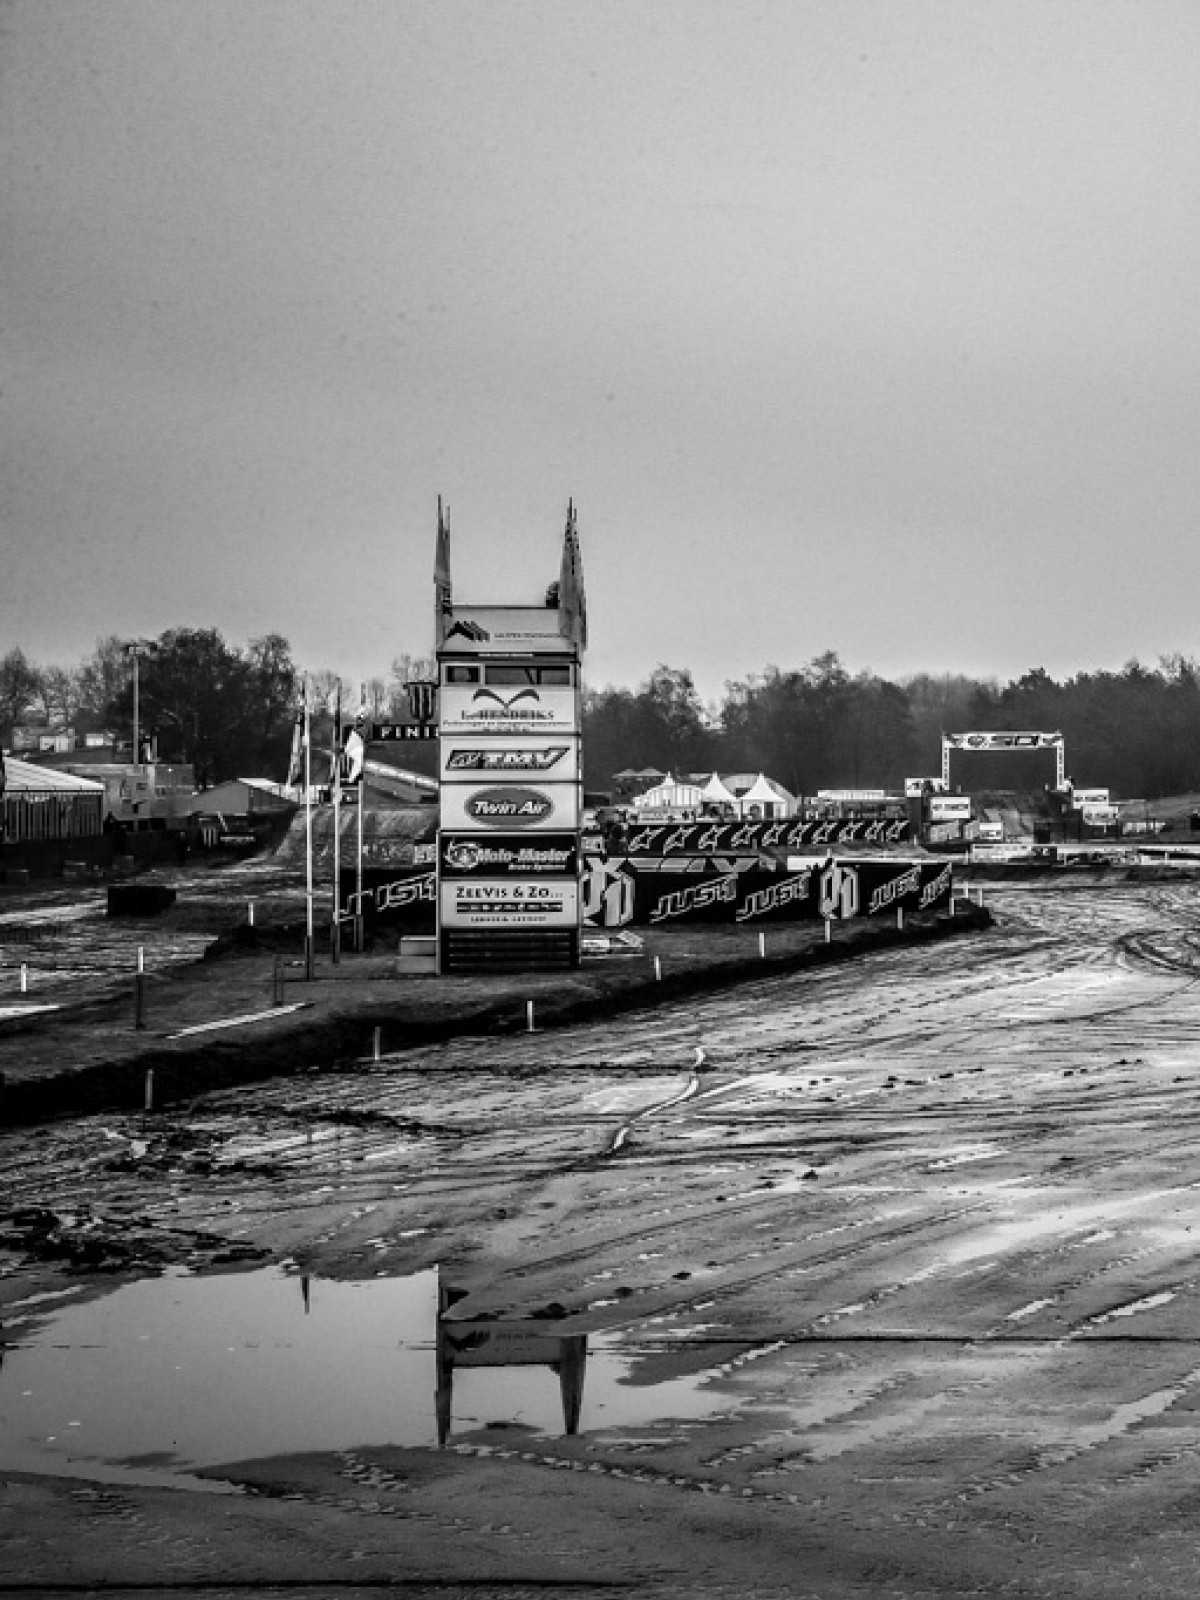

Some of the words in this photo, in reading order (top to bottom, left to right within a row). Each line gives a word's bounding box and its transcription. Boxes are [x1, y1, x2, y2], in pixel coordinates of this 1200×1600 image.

[474, 800, 516, 815] Twin
[517, 800, 548, 815] Air
[456, 885, 508, 899] ZEEVIS
